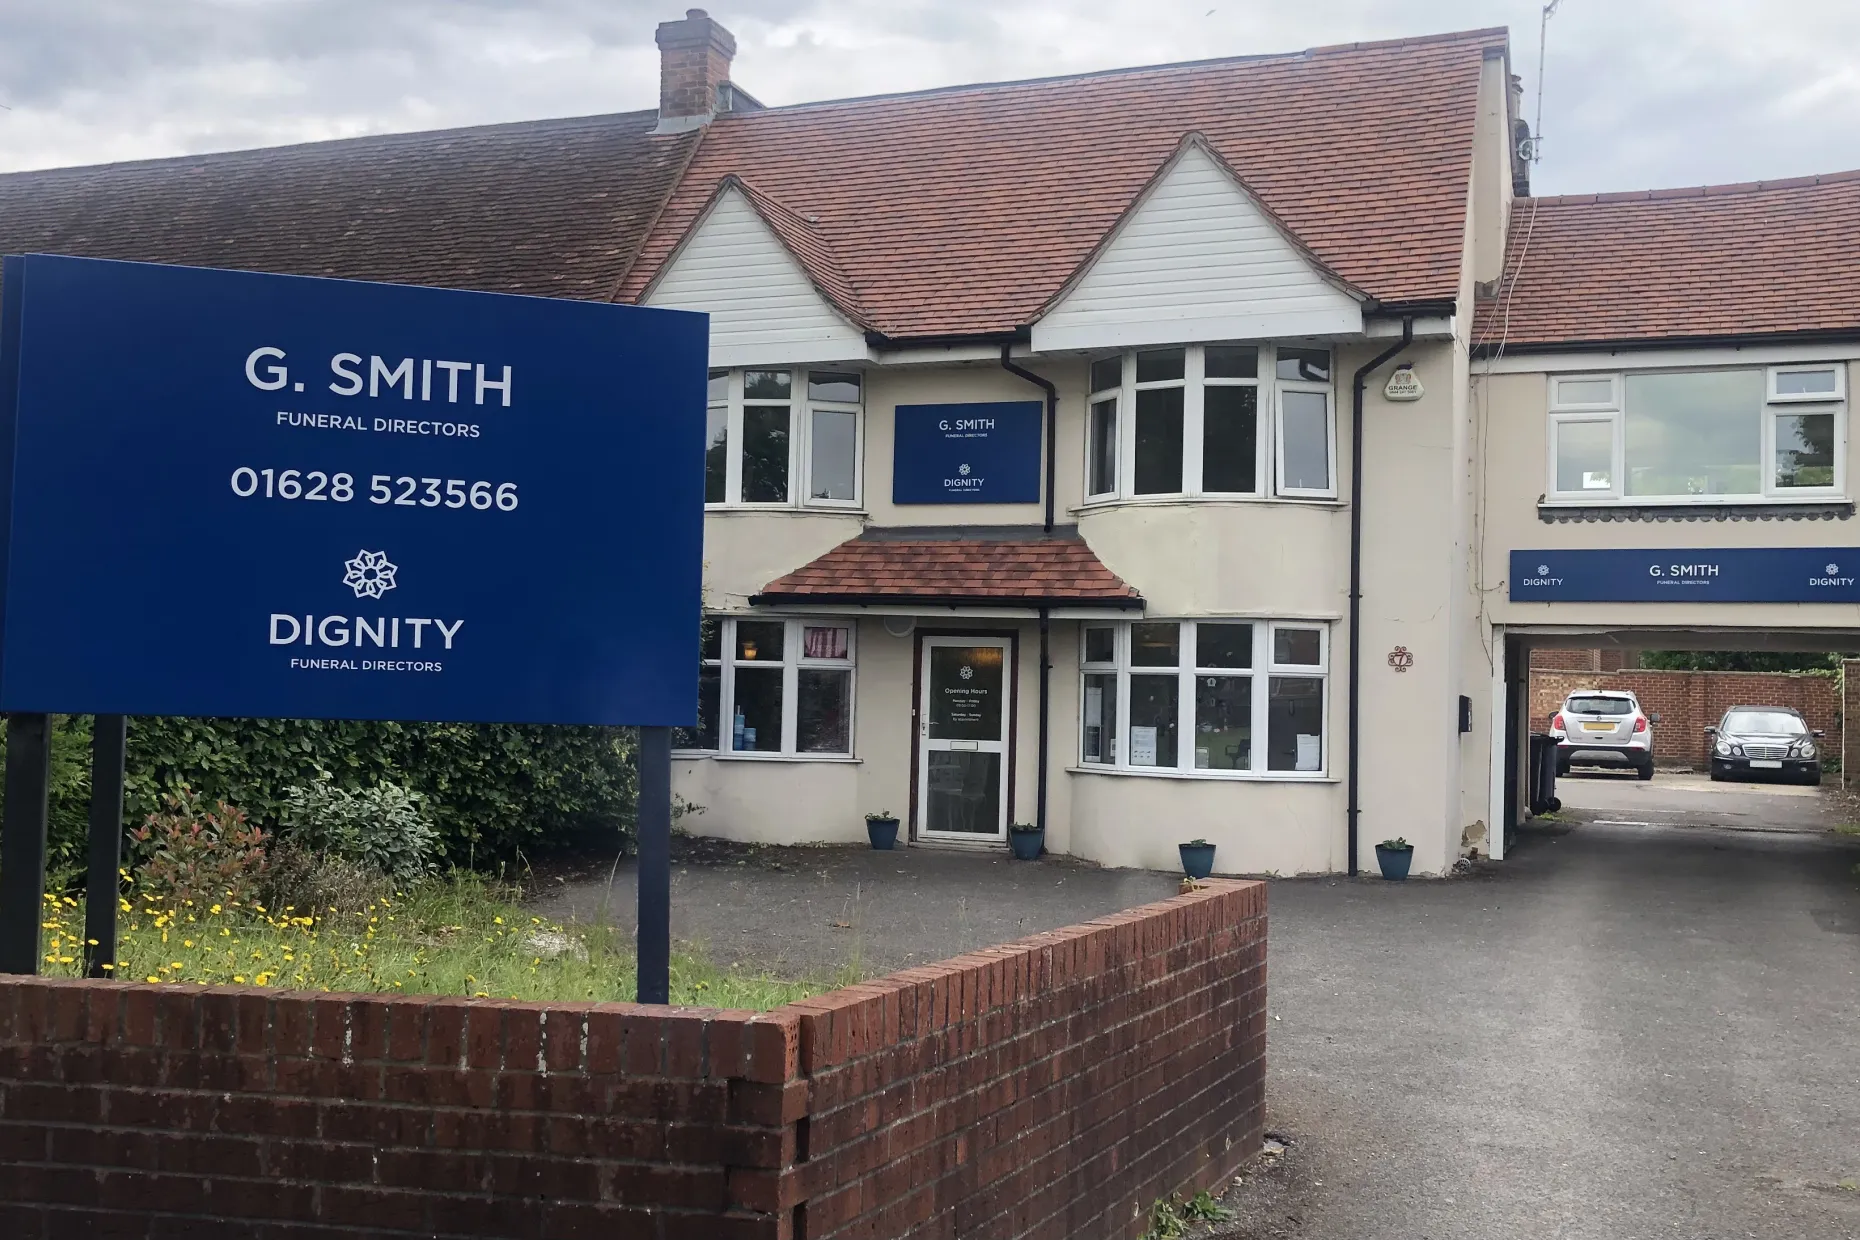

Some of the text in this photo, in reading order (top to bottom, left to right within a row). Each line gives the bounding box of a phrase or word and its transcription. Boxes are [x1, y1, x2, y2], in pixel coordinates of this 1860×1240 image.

[245, 346, 513, 407] G. SMITH
[276, 411, 480, 438] FUNERAL DIRECTORS
[939, 418, 995, 431] G. SMITH
[230, 466, 519, 511] 01628 523566
[944, 478, 985, 487] DIGNITY
[1649, 564, 1719, 577] G. SMITH
[1523, 578, 1564, 586] DIGNITY
[1809, 577, 1855, 586] DIGNITY
[269, 613, 465, 650] DIGNITY
[290, 658, 443, 673] FUNERAL DIRECTORS
